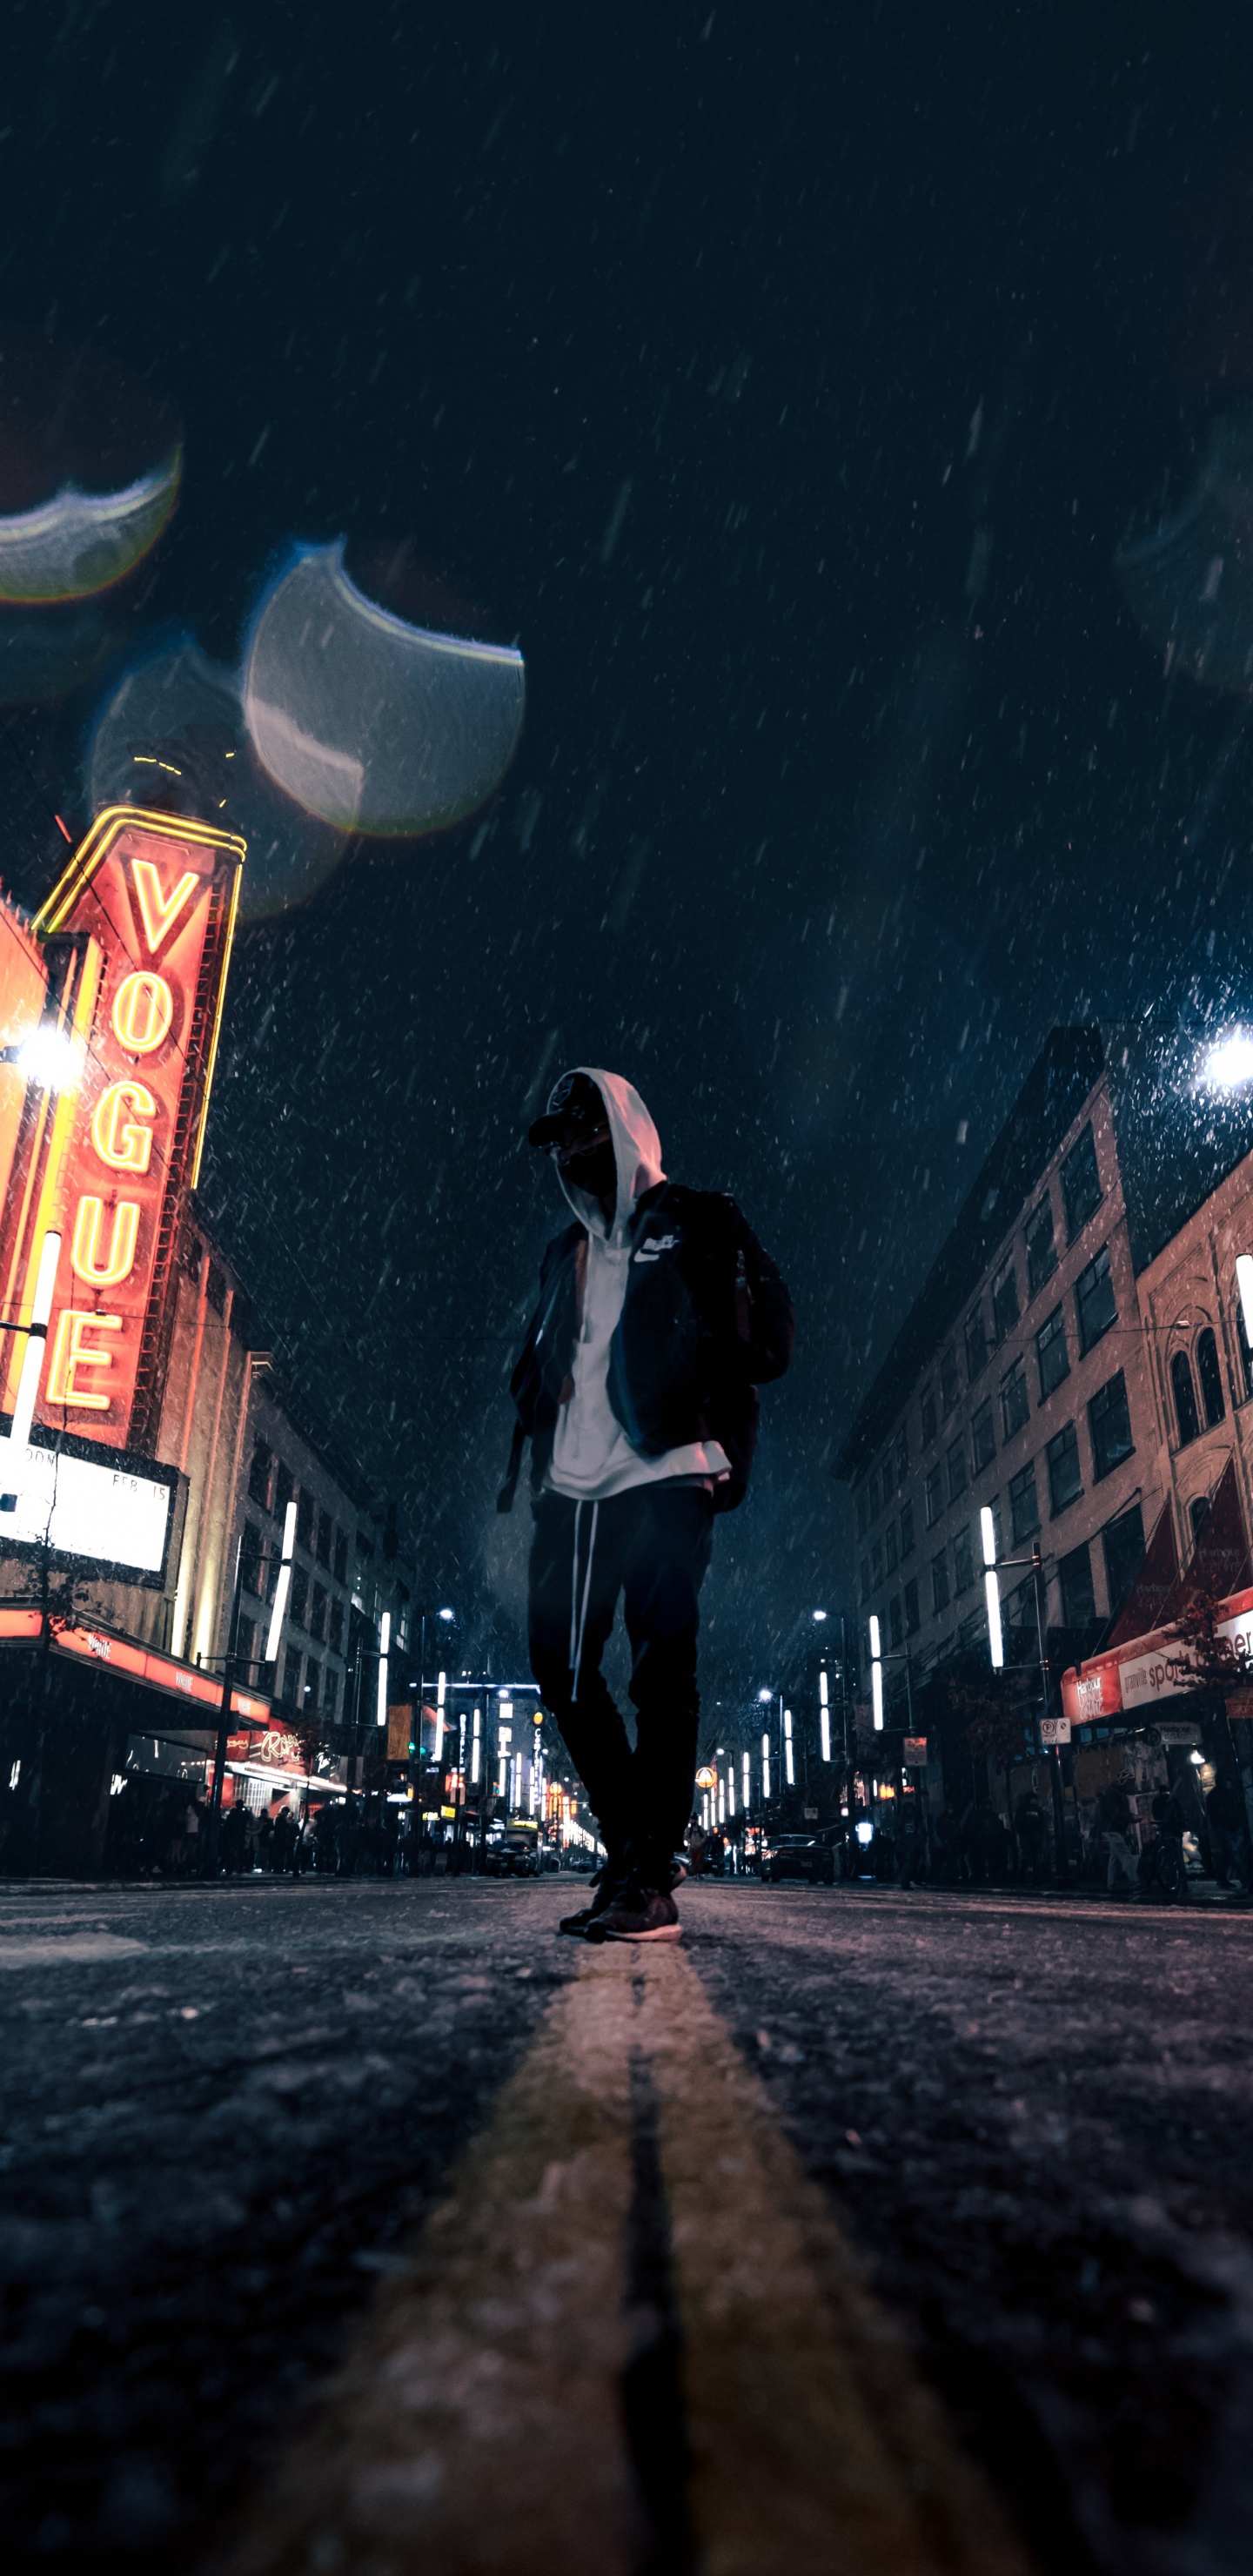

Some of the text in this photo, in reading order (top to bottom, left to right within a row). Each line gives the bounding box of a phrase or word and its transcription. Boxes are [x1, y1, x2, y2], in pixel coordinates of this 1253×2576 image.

[46, 860, 199, 1411] VOGUE
[112, 1474, 165, 1500] FEB 15
[1076, 1676, 1102, 1696] Harbour
